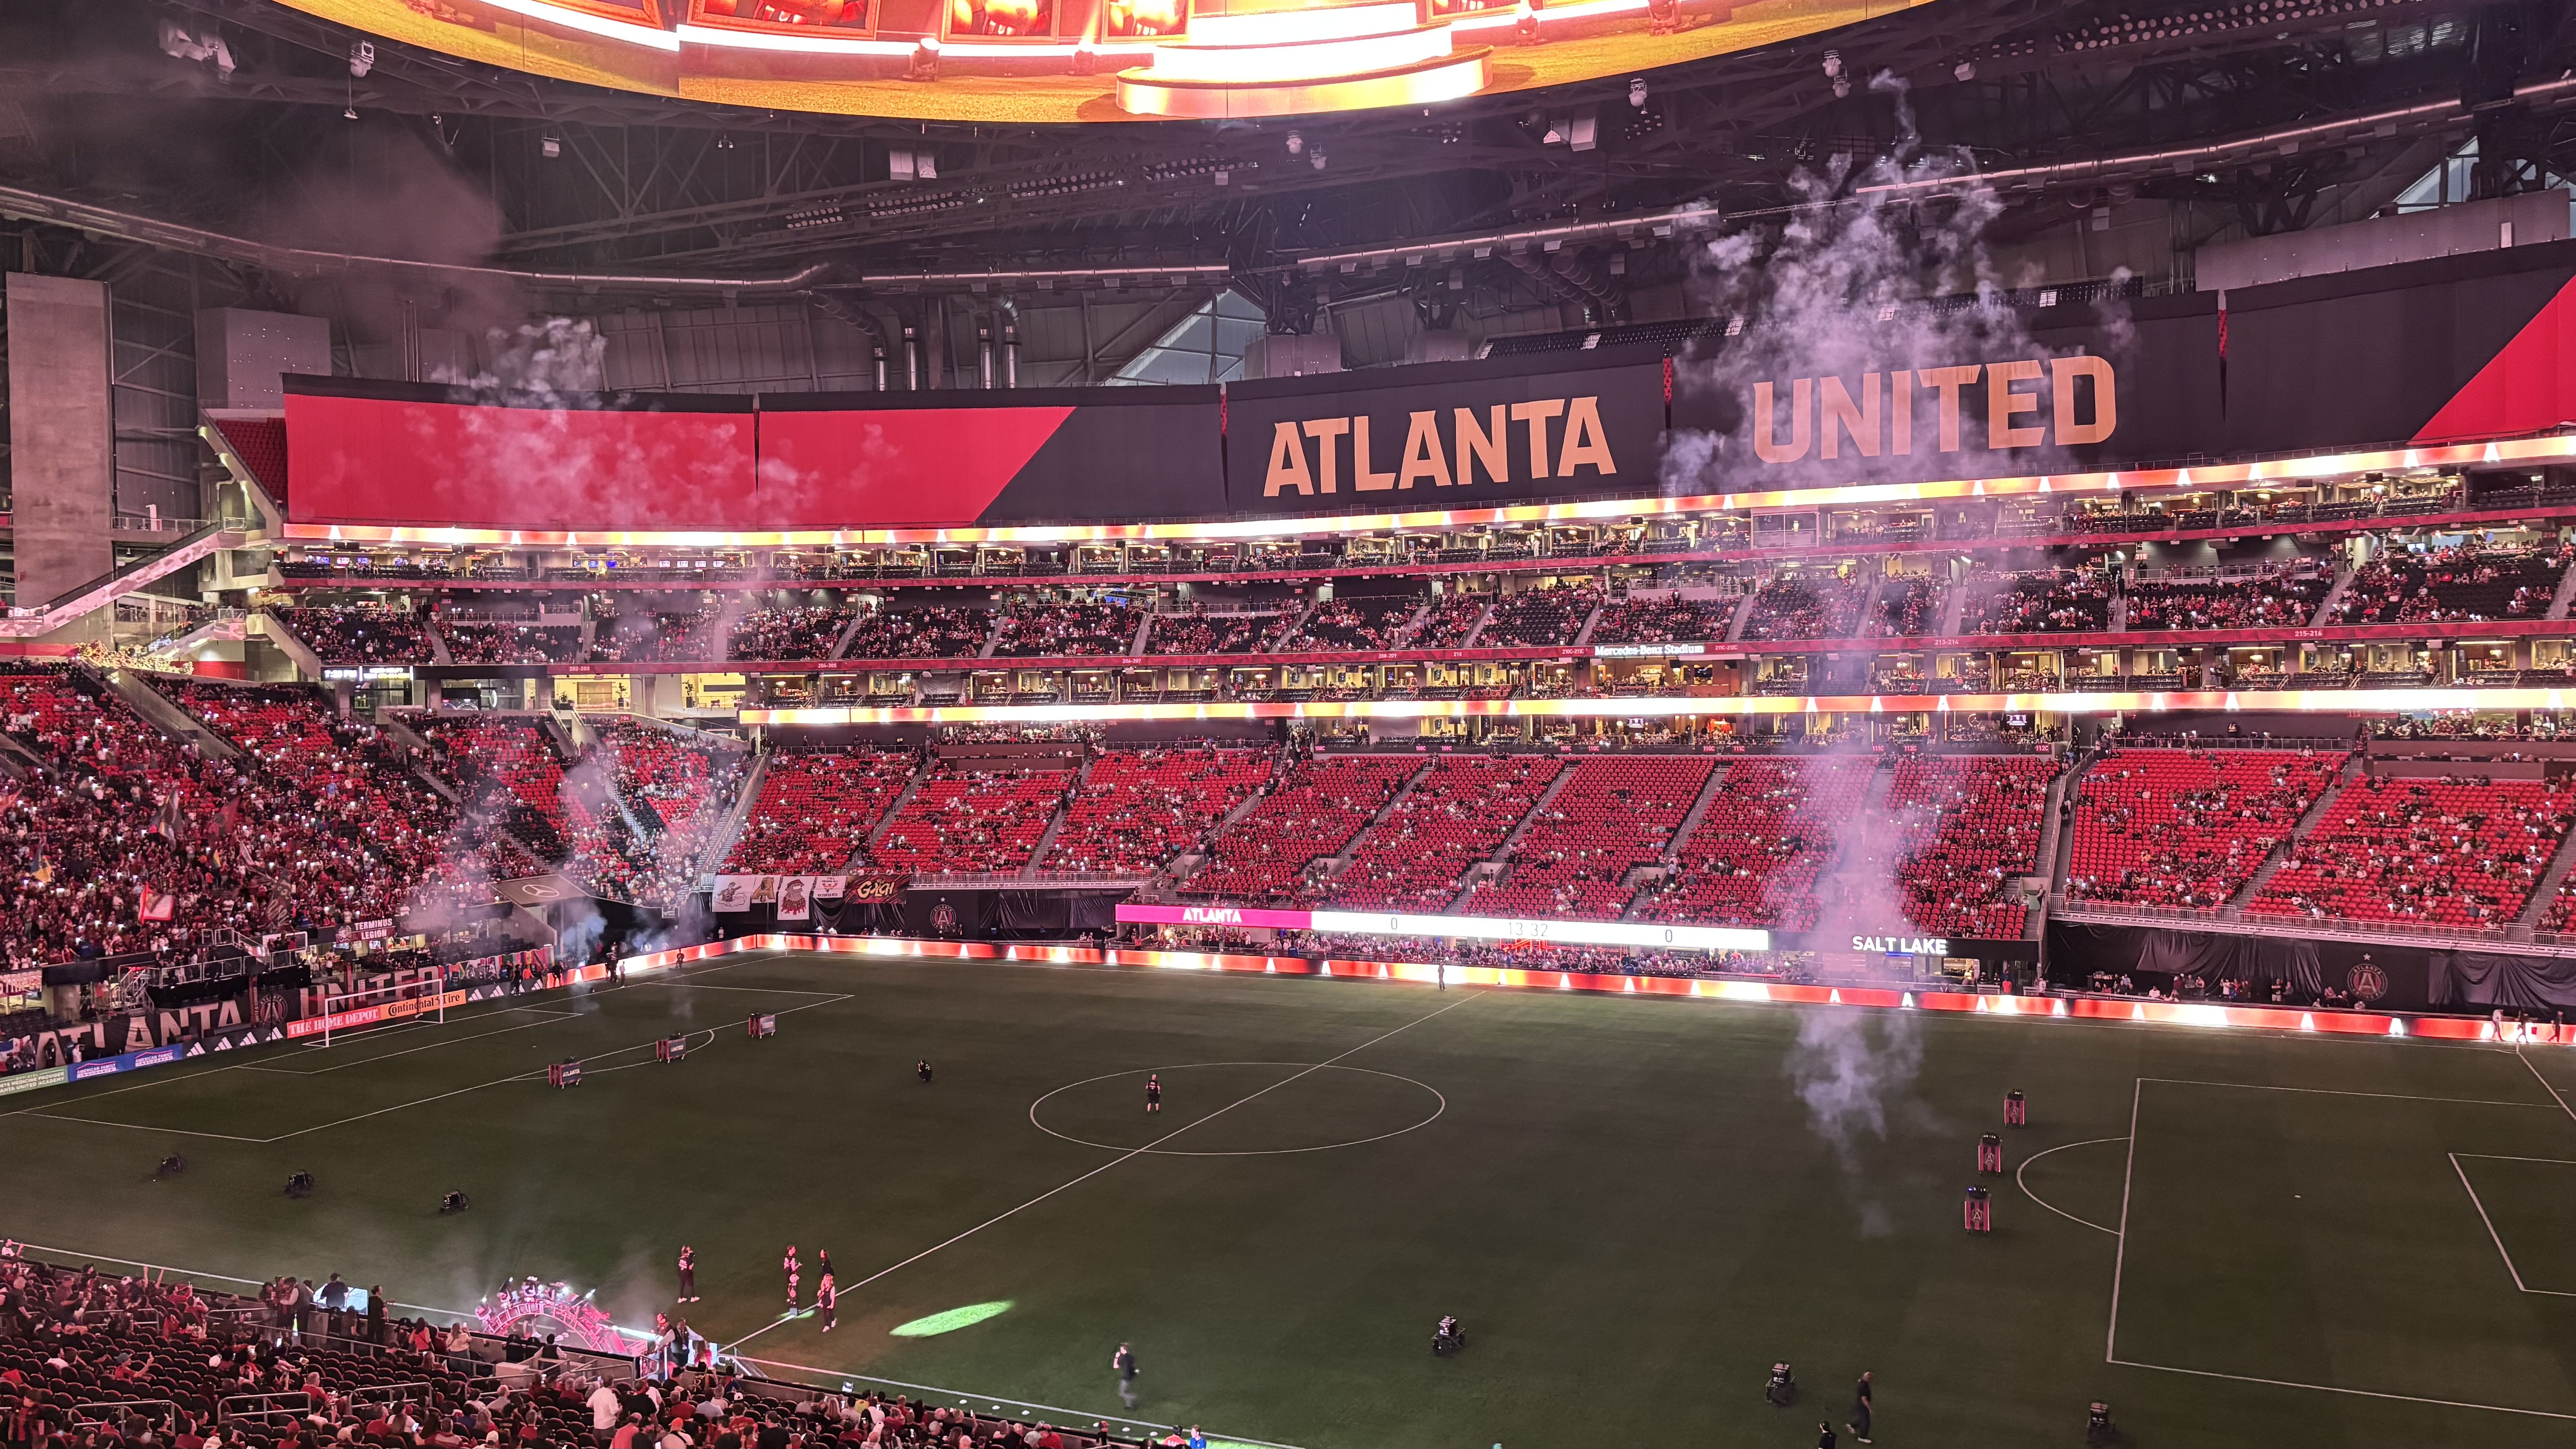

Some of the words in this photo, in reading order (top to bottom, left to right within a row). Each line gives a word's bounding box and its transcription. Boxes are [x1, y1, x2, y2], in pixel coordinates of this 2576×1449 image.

[1263, 396, 1617, 497] ATLANTA
[1753, 355, 2116, 464] UNITED
[1595, 645, 1662, 656] Mercedes-Benz
[1665, 644, 1703, 654] Stadium
[857, 881, 895, 898] GULCH
[1183, 908, 1242, 923] ATLANTA
[354, 918, 392, 931] TERMINUS
[1390, 917, 1398, 930] 0
[361, 929, 387, 940] LEGION
[1665, 929, 1673, 943] 0
[1853, 936, 1896, 952] SALT
[1900, 938, 1947, 955] LAKE
[388, 997, 434, 1016] Continental
[442, 994, 460, 1004] Tire
[289, 1021, 312, 1035] THE
[314, 1015, 343, 1030] HOME
[345, 1008, 378, 1025] DEPOT
[38, 1072, 64, 1081] PROVIDER
[562, 1068, 580, 1077] ATLANTA
[16, 1082, 37, 1090] UNITED
[38, 1076, 65, 1086] ACADEMY
